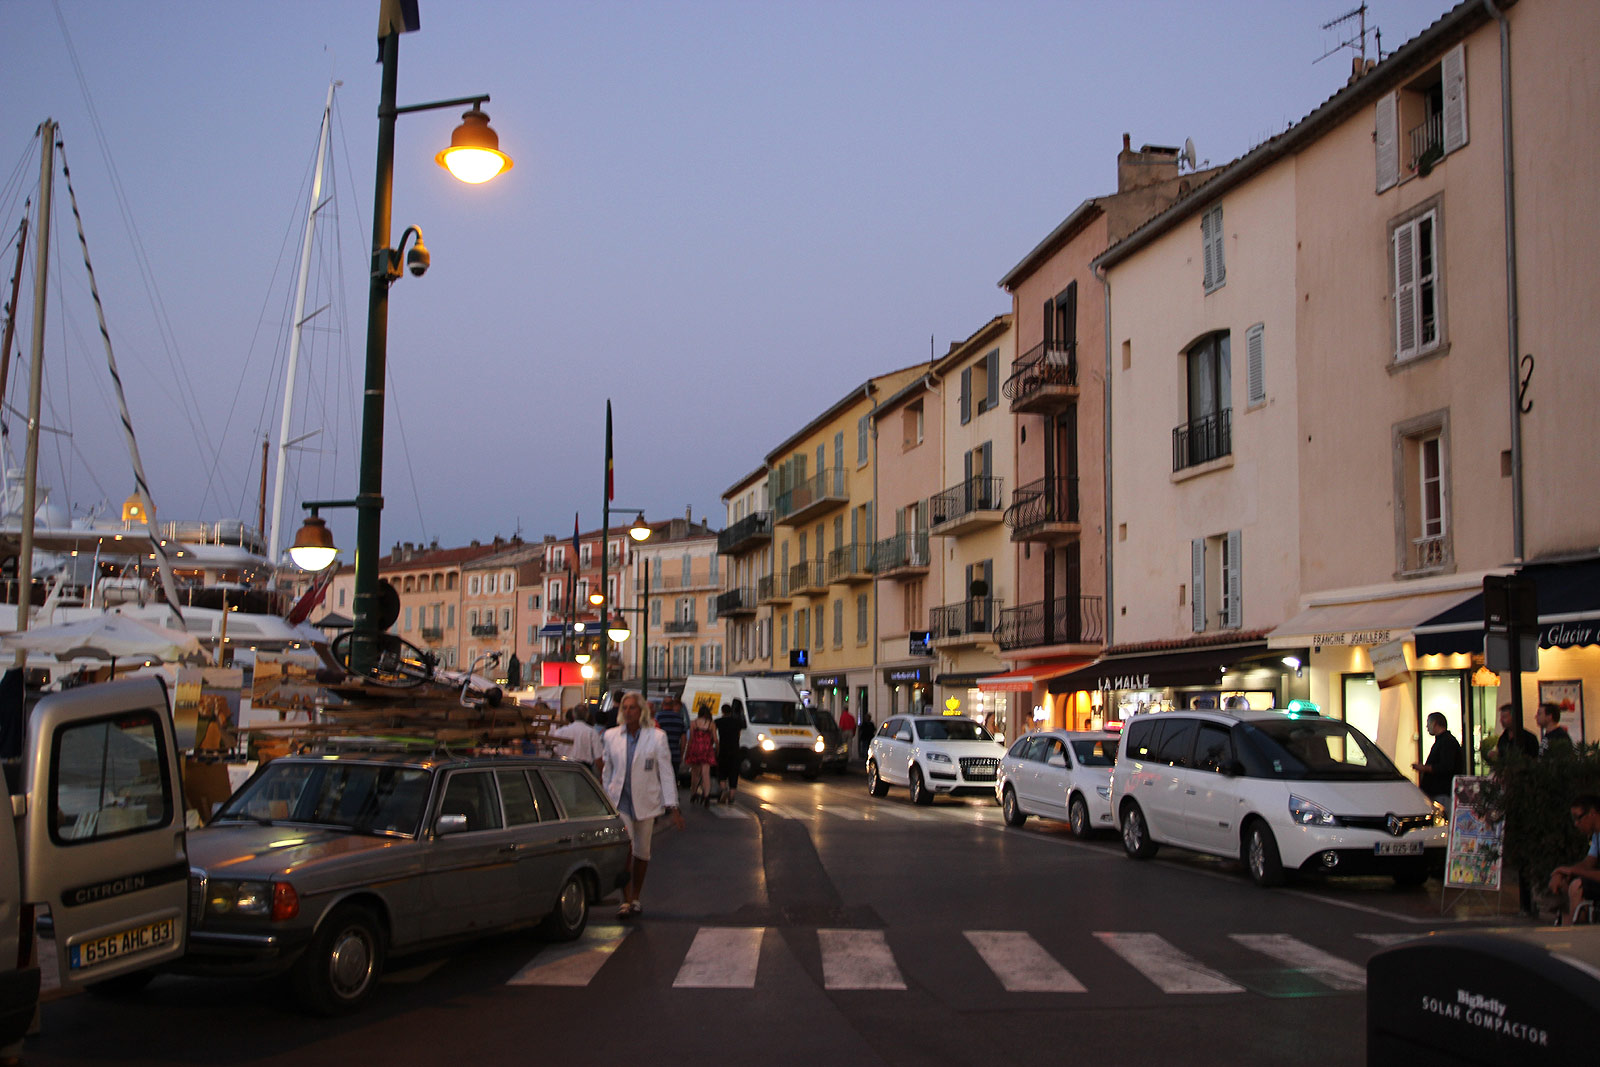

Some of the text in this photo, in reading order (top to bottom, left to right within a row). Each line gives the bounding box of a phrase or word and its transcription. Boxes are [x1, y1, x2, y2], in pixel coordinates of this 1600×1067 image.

[1548, 623, 1592, 645] Glacier
[1098, 674, 1150, 691] LA HALLE
[86, 923, 170, 962] 656 AHC 83
[1457, 989, 1508, 1017] BigBelly
[1422, 995, 1548, 1046] SOLAR COMPACTOR
